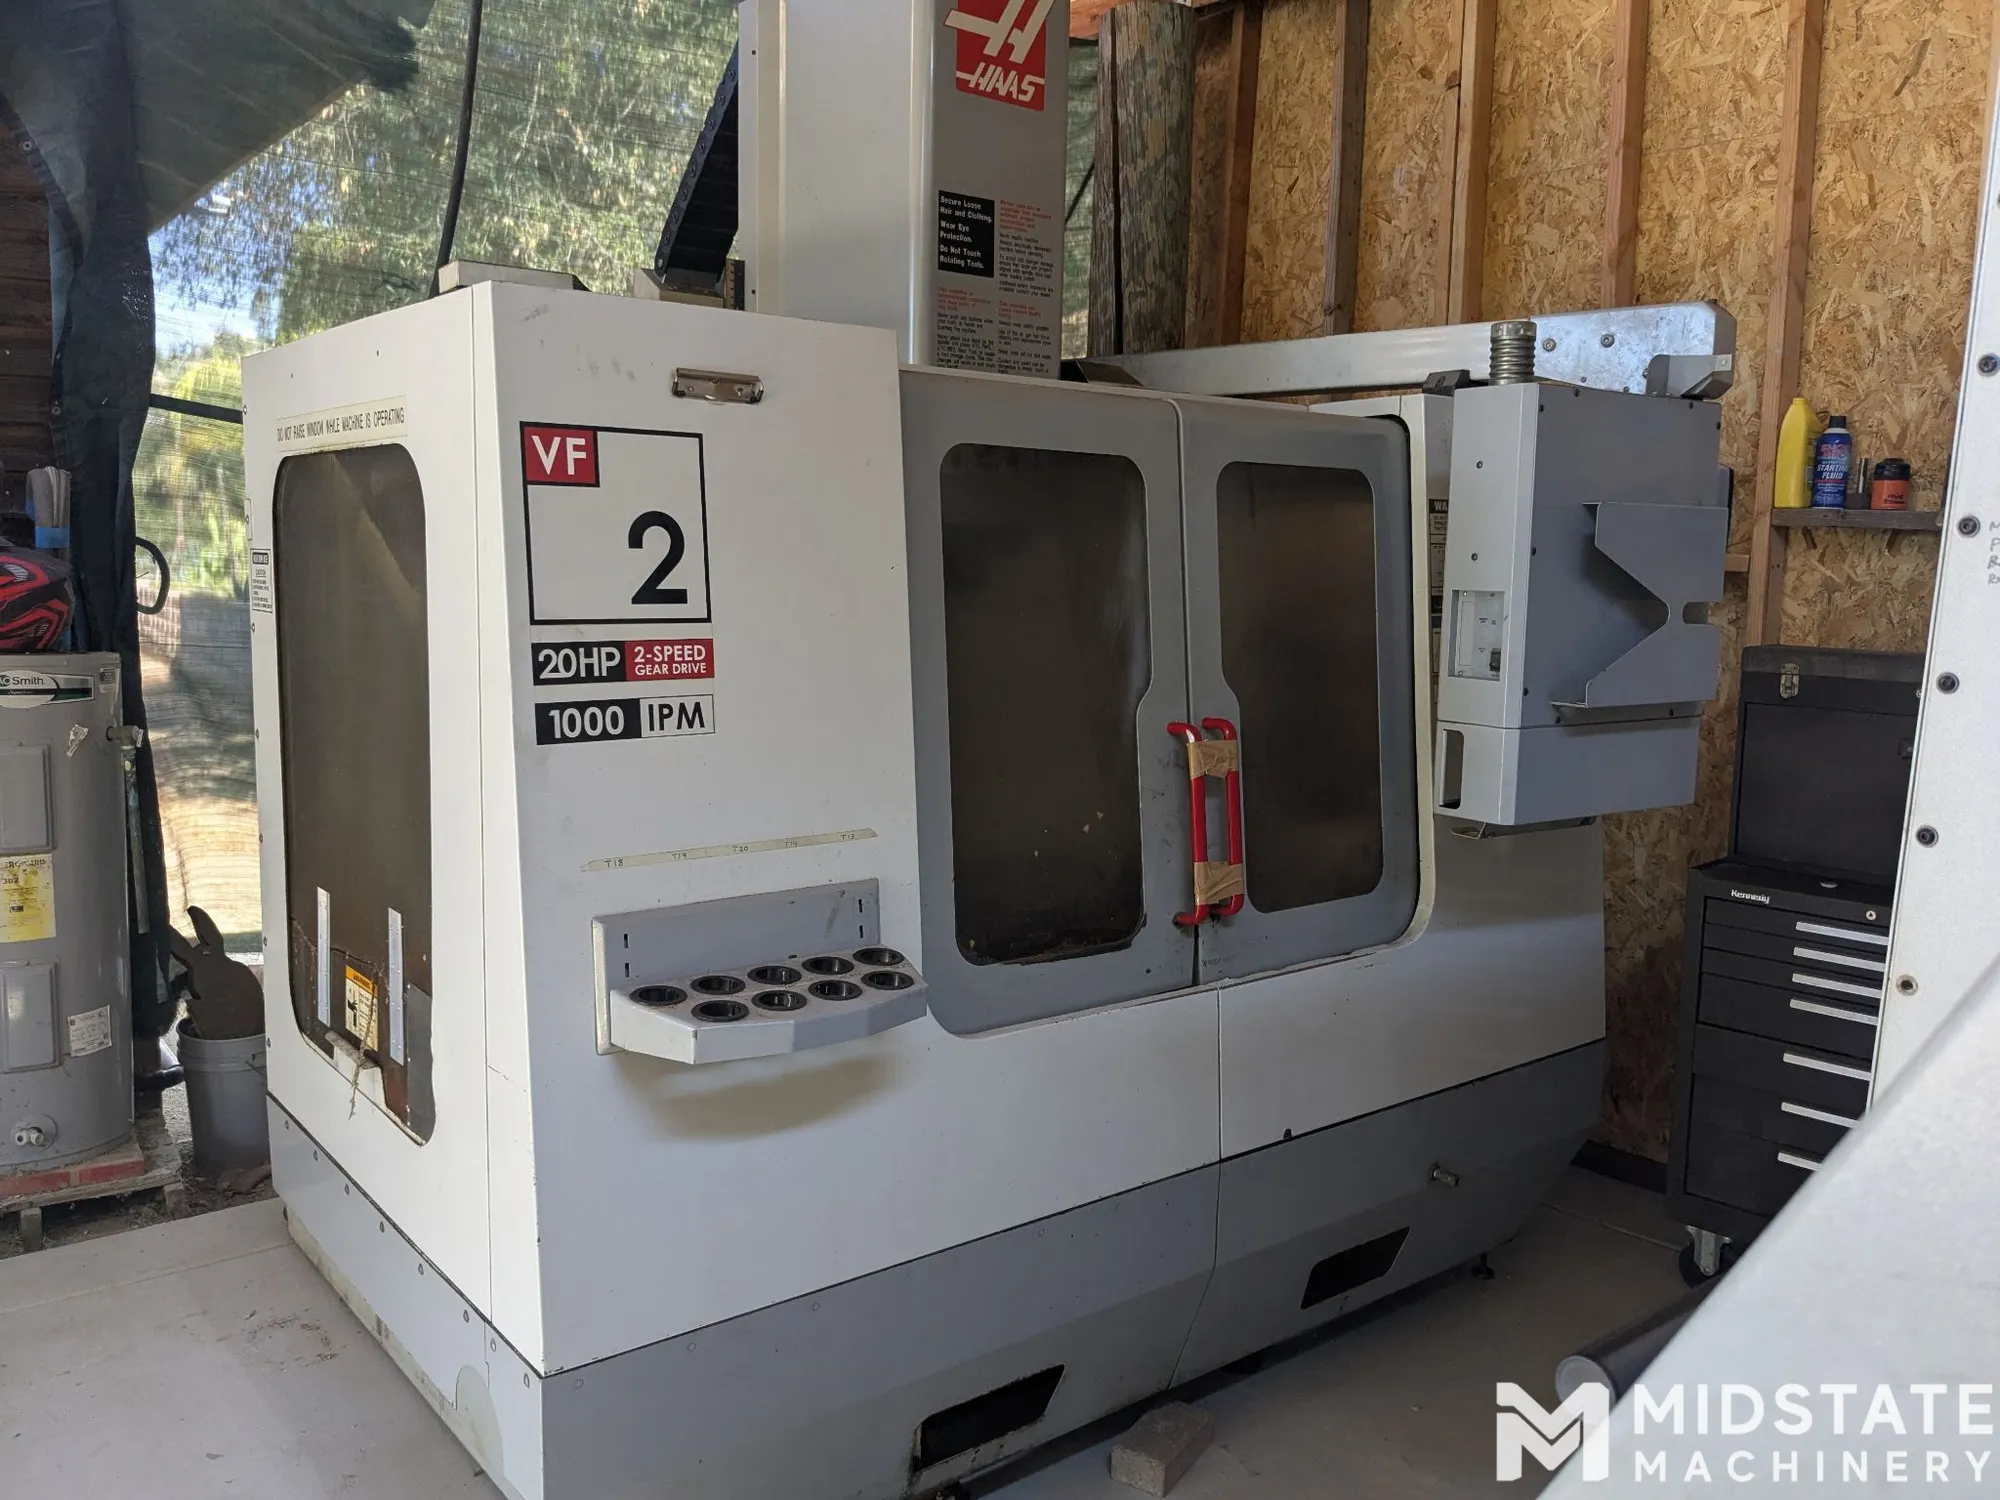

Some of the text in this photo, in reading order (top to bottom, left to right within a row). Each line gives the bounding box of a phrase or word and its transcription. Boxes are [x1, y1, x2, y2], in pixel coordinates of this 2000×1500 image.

[956, 61, 1045, 102] HAAS
[940, 196, 981, 210] Secure Loose
[940, 206, 952, 215] Hair
[955, 210, 966, 218] and
[940, 220, 970, 232] Wear Eye
[940, 230, 972, 243] Protection.
[940, 244, 981, 258] Do Not Touch
[940, 254, 965, 268] Rotating
[293, 423, 306, 439] RAISE
[307, 420, 324, 437] WINDOW
[325, 417, 340, 434] WHILE
[342, 413, 364, 432] MACHINE
[365, 411, 371, 428] IS
[374, 406, 405, 428] OPERATING
[531, 435, 587, 476] VF
[1821, 471, 1843, 479] FLUID
[628, 510, 688, 604] 2
[538, 645, 706, 680] 20HP 2-SPEED
[635, 663, 707, 676] GEAR DRIVE
[12, 677, 44, 685] Smith
[549, 701, 705, 739] 1000 IPM
[604, 858, 624, 868] T18
[671, 852, 687, 860] T19
[1731, 889, 1770, 904] Kennedy
